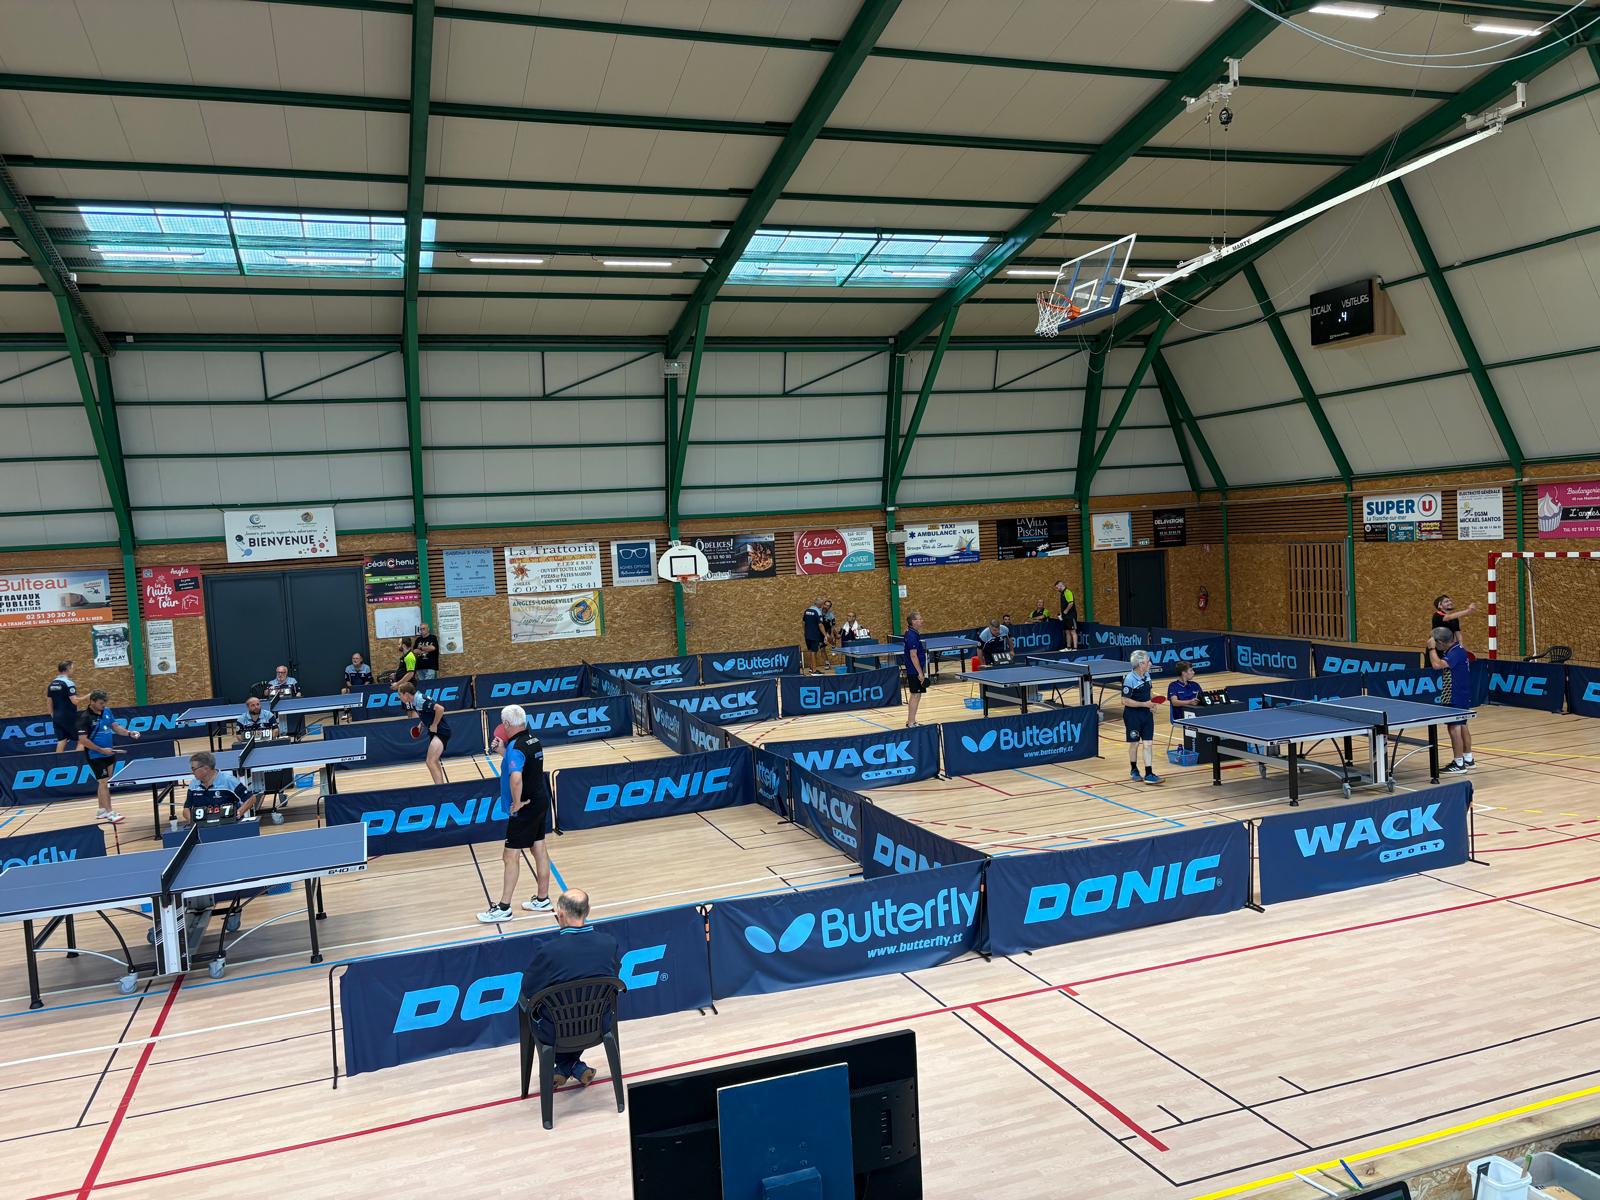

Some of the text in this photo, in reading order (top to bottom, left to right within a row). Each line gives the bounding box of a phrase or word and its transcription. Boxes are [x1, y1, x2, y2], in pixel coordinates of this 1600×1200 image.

[1232, 240, 1251, 251] MARTY
[1341, 294, 1370, 308] VISITEURS
[1366, 500, 1432, 516] SUPER U
[1017, 526, 1049, 537] PISCINE
[248, 535, 315, 547] BIENVENUE
[802, 538, 812, 548] Le
[509, 543, 596, 556] La Trattoria
[0, 578, 68, 592] Bulteau
[147, 584, 172, 597] Nuits
[0, 593, 40, 601] TRAVAUX
[0, 600, 41, 608] PUBLICS
[157, 596, 179, 608] Tour
[512, 598, 574, 606] ANGLES-LONGEVILLE
[1012, 632, 1051, 648] andro
[1109, 632, 1142, 646] Butterfly
[97, 654, 126, 663] FAIR-PLAY
[1148, 645, 1211, 664] WACK
[1253, 651, 1297, 670] andro
[737, 654, 789, 672] Butterfly
[609, 663, 682, 680] WACK
[491, 676, 578, 698] DONIC
[669, 690, 758, 713] WACK
[822, 685, 883, 706] andro
[1205, 694, 1226, 704] 5 7
[524, 706, 610, 730] WACK
[262, 730, 270, 738] 10
[1000, 720, 1081, 750] Butterfly
[793, 741, 914, 771] WACK
[1024, 746, 1074, 758] www.butterfly.tt
[864, 766, 913, 779] SPORT
[584, 767, 731, 812] DONIC
[800, 777, 857, 830] WACK
[195, 805, 232, 820] 9 7
[1294, 803, 1442, 858] WACK
[1384, 842, 1440, 861] SPORT
[1024, 854, 1220, 924] DONIC
[821, 887, 979, 949] Butterfly
[867, 932, 963, 959] www.butterfly.tt
[393, 944, 666, 1034] DOC
